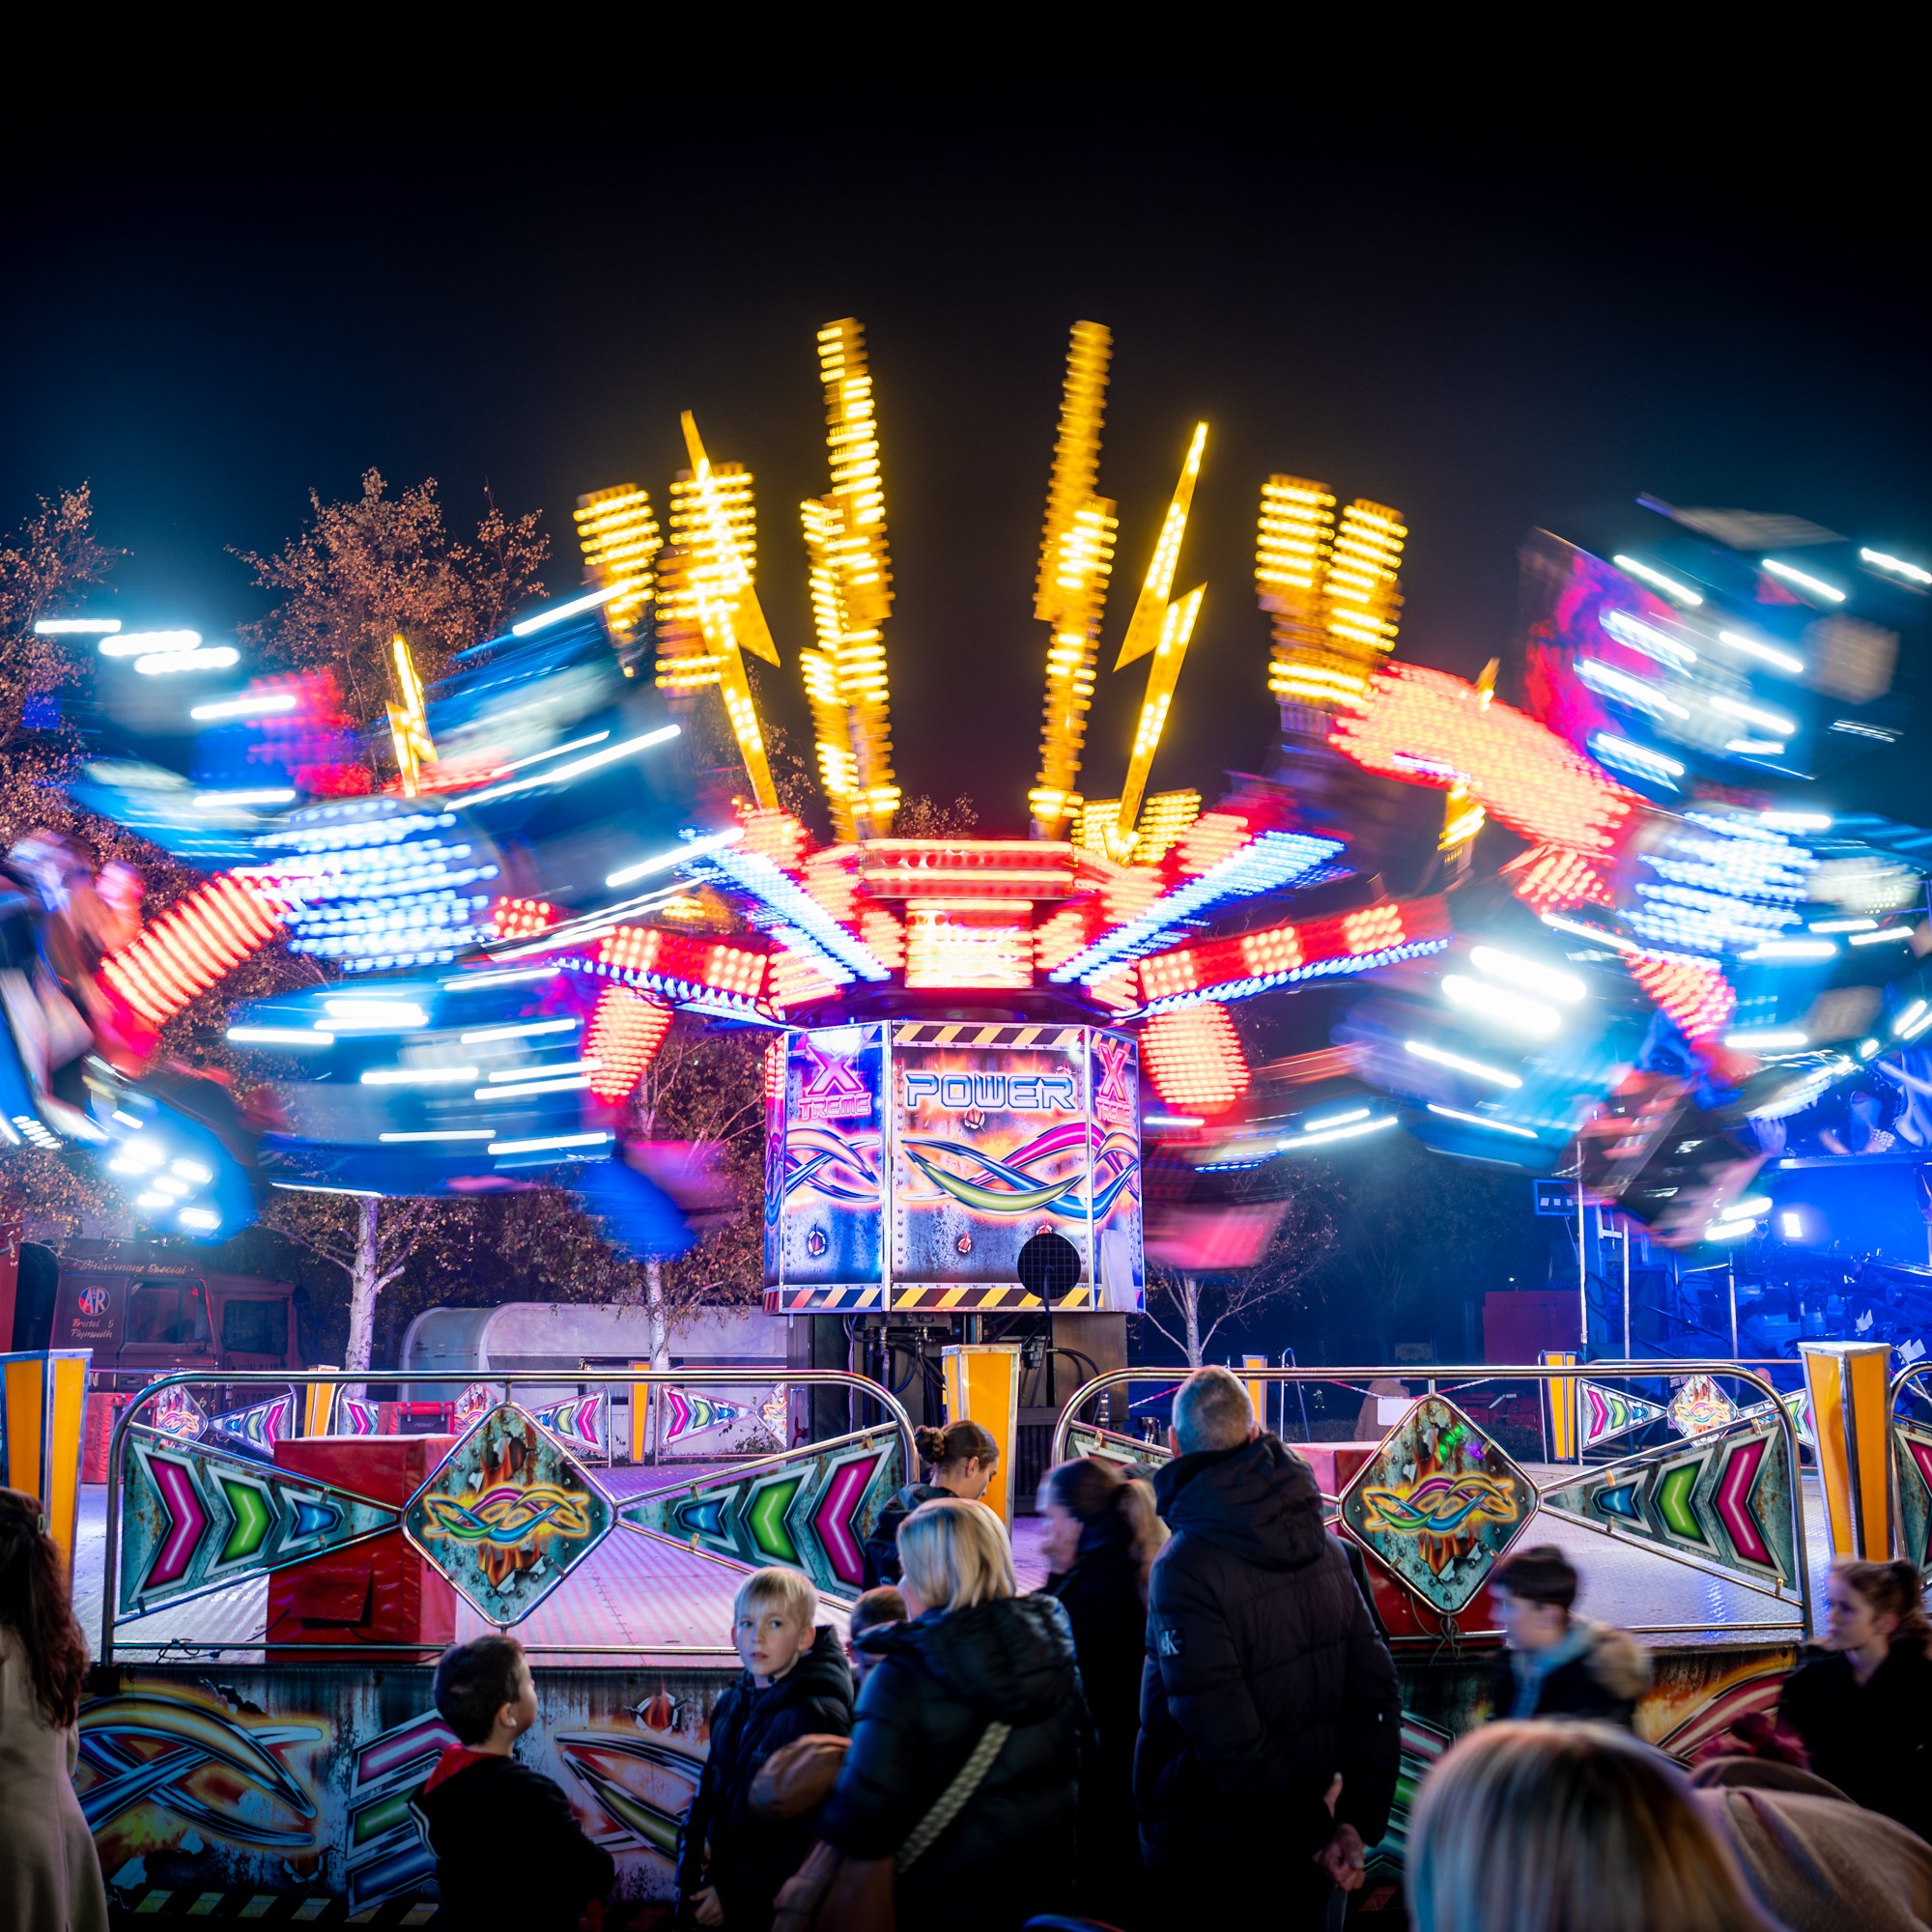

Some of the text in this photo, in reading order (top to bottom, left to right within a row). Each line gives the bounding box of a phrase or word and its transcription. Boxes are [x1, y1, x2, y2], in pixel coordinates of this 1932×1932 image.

[807, 1043, 864, 1095] X
[1098, 1043, 1128, 1103] X
[798, 1093, 872, 1120] TREME
[905, 1073, 1077, 1110] POWER
[71, 1328, 114, 1341] Plymouth
